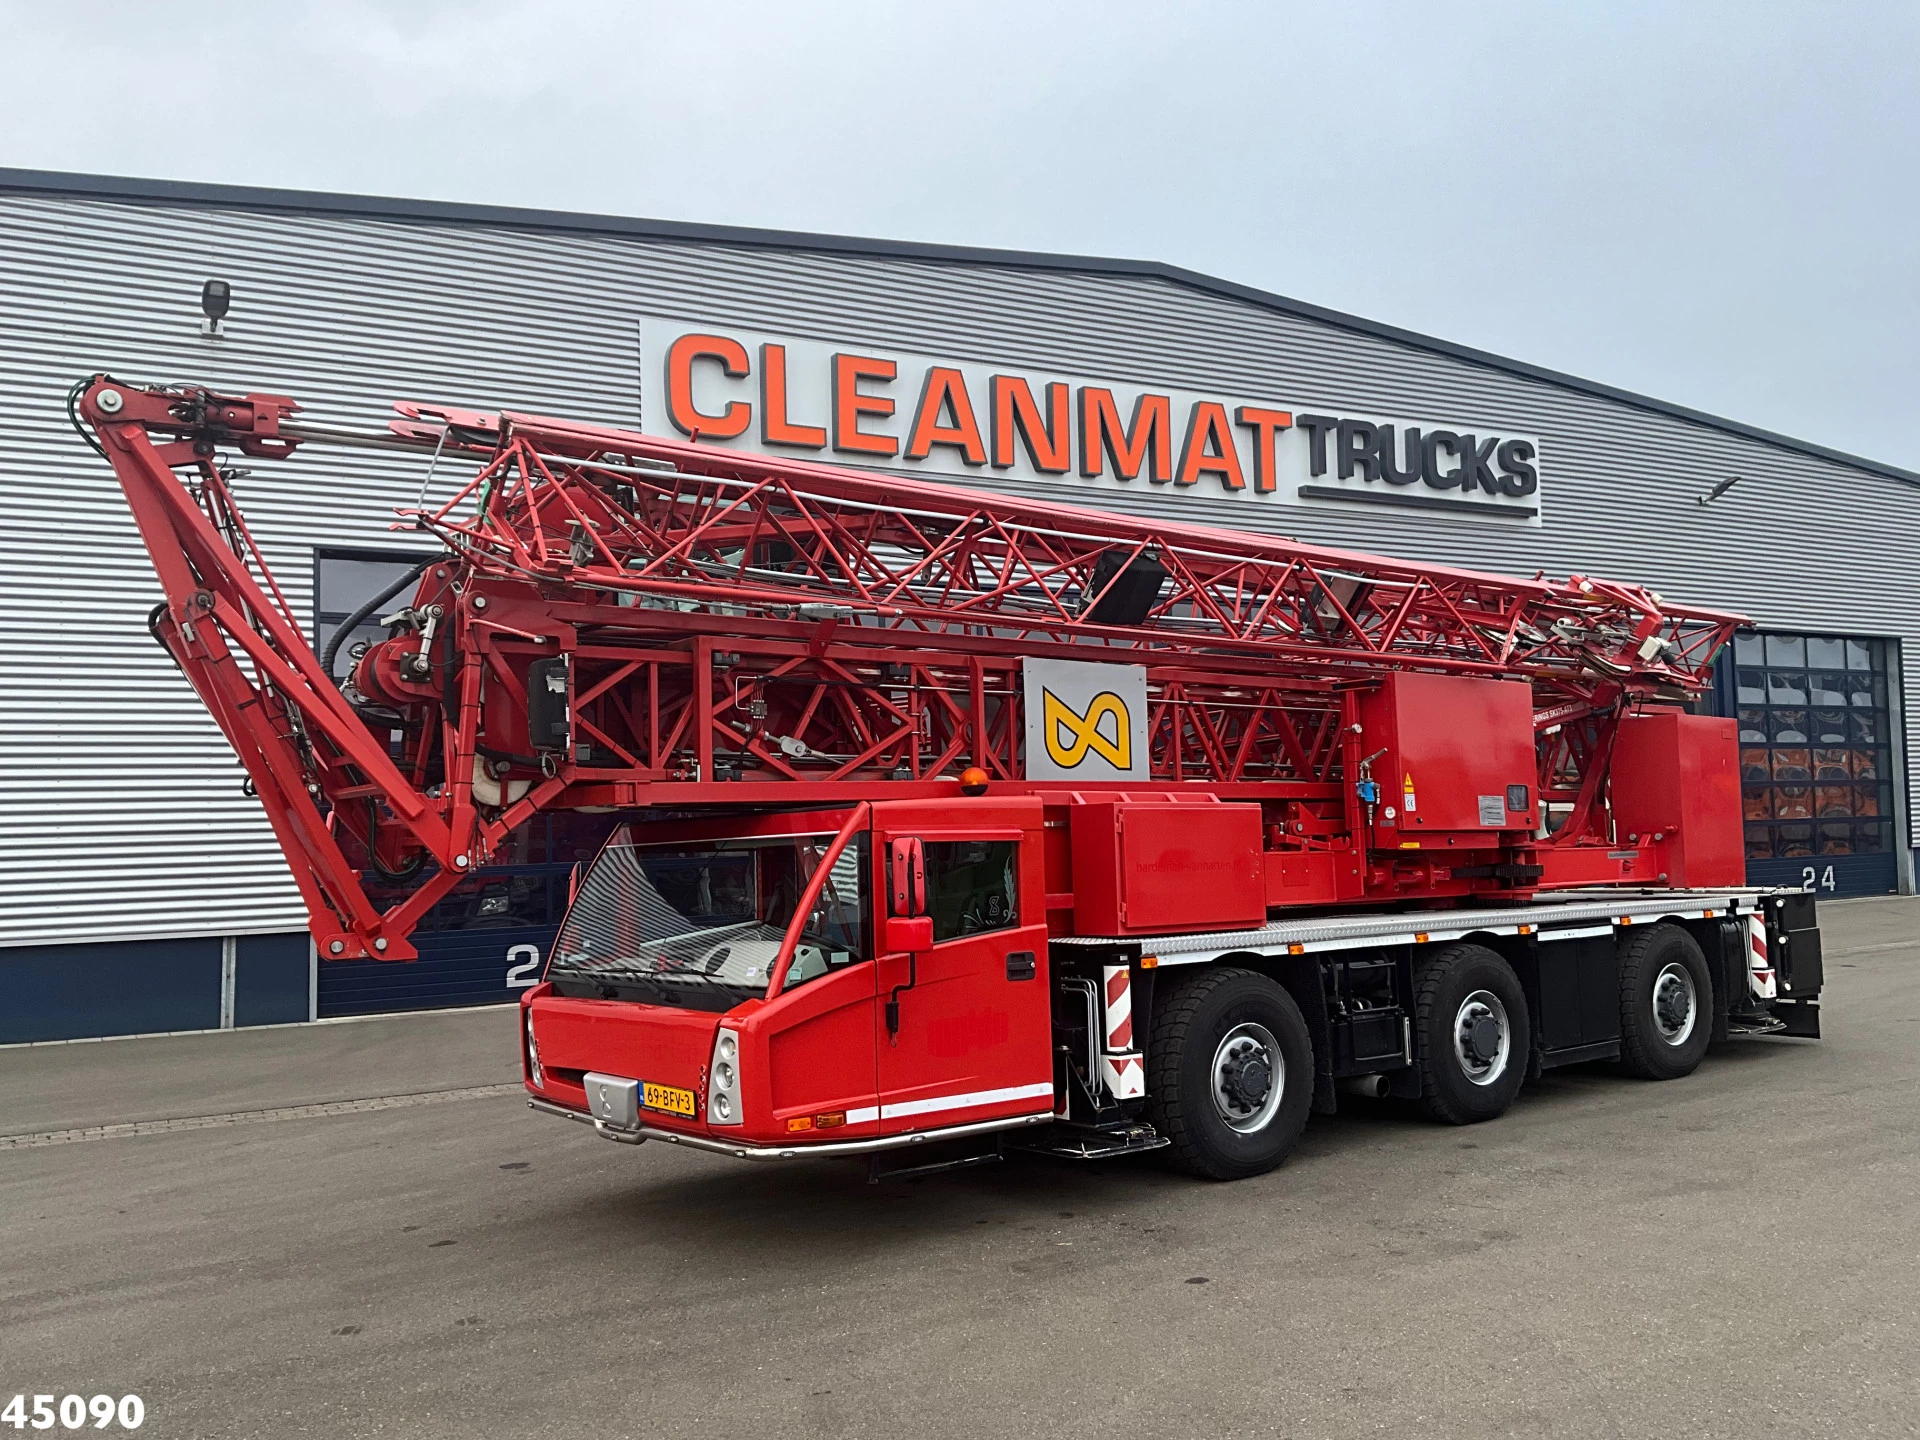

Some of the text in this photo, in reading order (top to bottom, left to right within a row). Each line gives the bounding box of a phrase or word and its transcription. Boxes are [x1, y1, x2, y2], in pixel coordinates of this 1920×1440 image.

[665, 333, 1537, 497] CLEANMAT TRUCKS
[647, 1086, 691, 1111] 69-BFV-3
